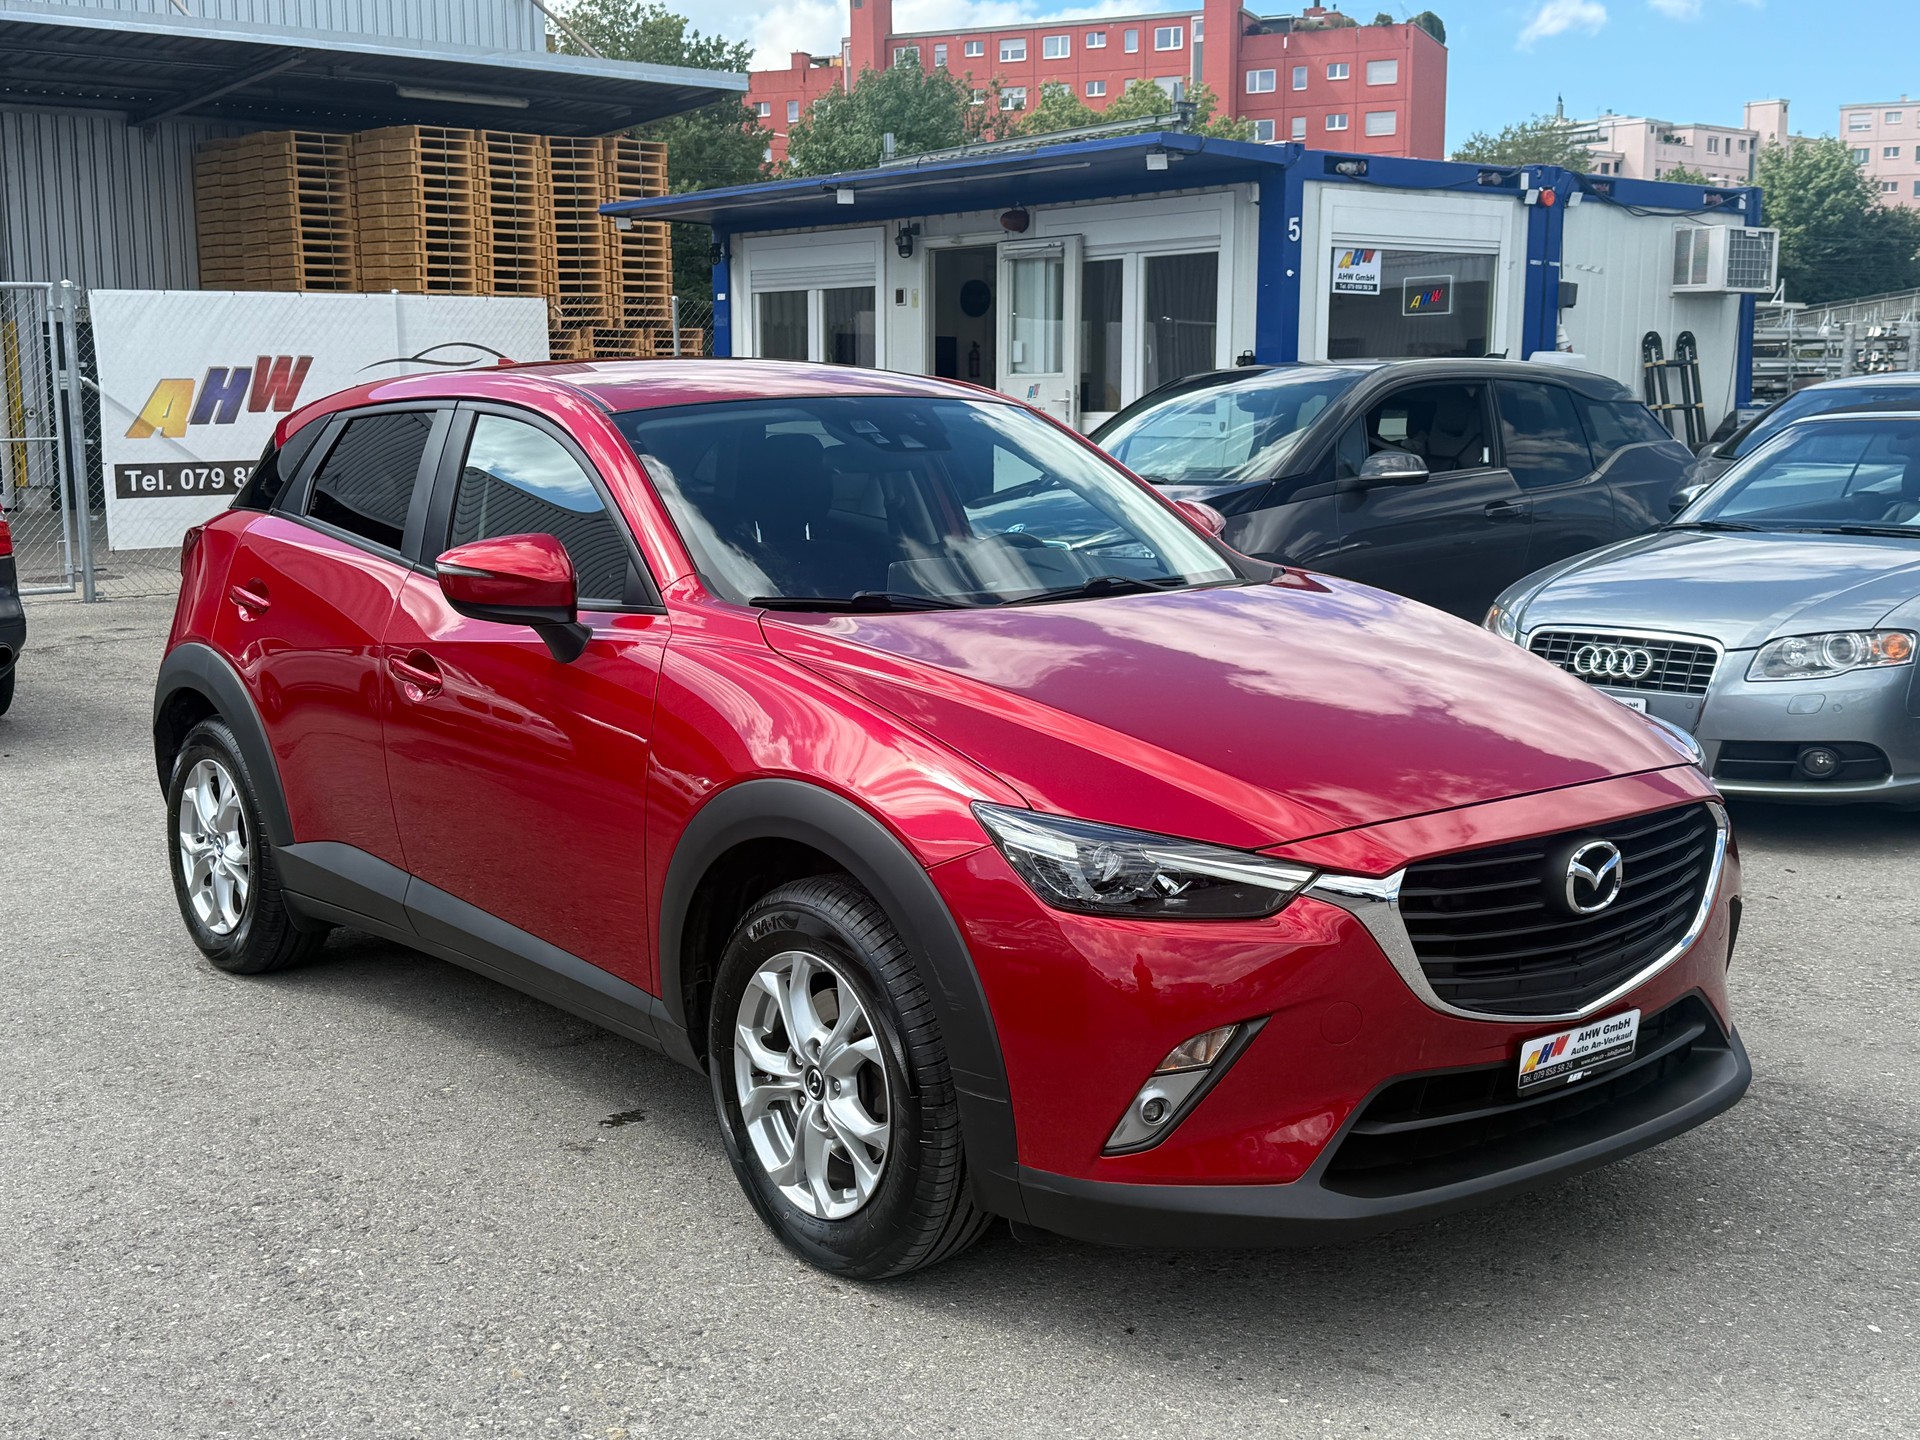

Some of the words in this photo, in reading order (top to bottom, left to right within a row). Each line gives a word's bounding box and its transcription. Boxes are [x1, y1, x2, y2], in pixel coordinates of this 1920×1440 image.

[1288, 217, 1300, 242] 5
[1338, 248, 1376, 269] AHW
[1338, 272, 1354, 281] AHW
[1355, 273, 1376, 282] GmbH
[1410, 289, 1444, 309] AHW
[124, 355, 314, 439] AHW
[124, 469, 172, 492] Tel.
[180, 467, 225, 490] 079
[233, 466, 254, 489] 8
[1571, 1045, 1590, 1056] Auto
[1591, 1029, 1633, 1050] An-Verkauf
[1578, 1026, 1601, 1043] AHW
[1602, 1017, 1631, 1035] GmbH
[1520, 1033, 1571, 1074] AHW
[1522, 1074, 1533, 1084] Tel.
[1533, 1070, 1545, 1081] 079
[1565, 1061, 1574, 1070] 24
